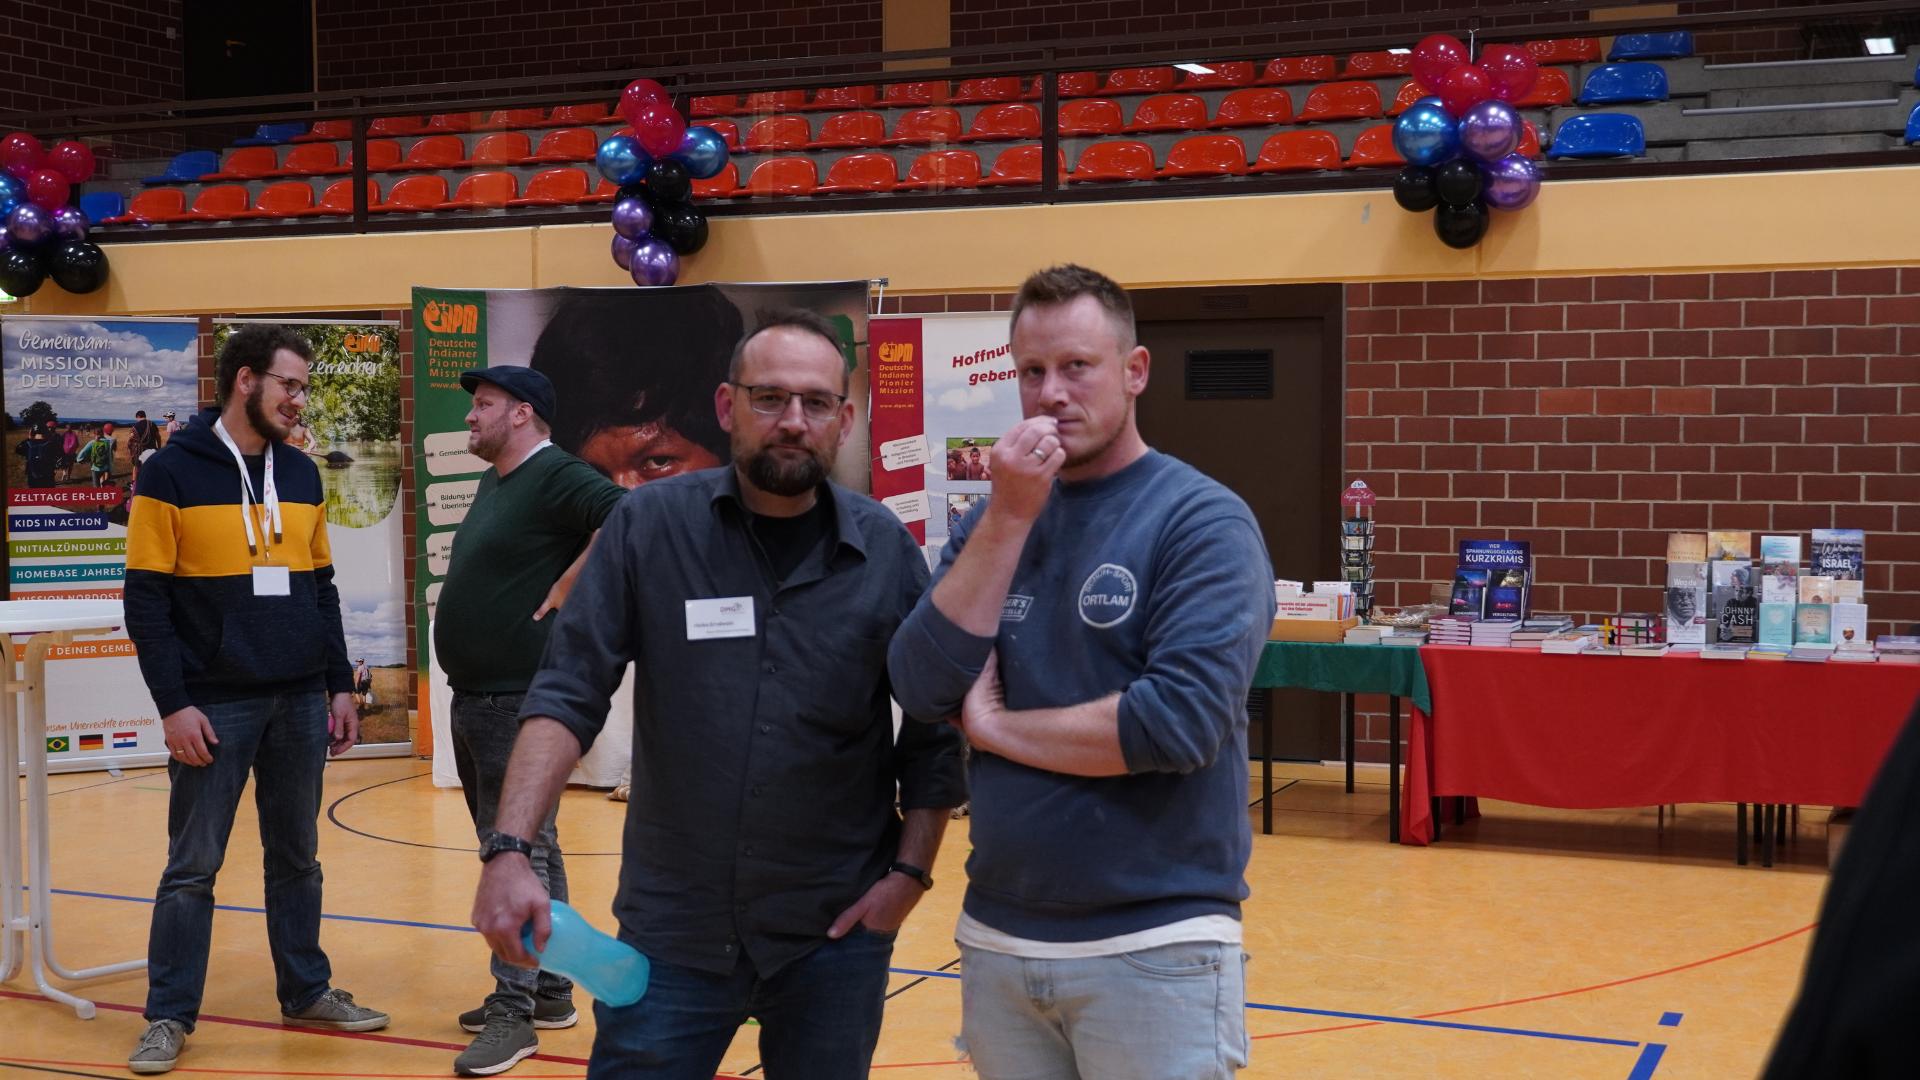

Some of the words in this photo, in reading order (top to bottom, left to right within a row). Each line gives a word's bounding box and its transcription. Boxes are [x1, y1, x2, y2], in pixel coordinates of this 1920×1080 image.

[429, 338, 477, 348] Deutsche
[429, 348, 478, 358] Indianer
[21, 357, 102, 370] MISSION
[109, 357, 128, 369] IN
[429, 358, 478, 368] Pionier
[22, 375, 164, 388] DEUTSCHLAND
[969, 369, 1017, 386] geben
[14, 493, 68, 502] ZELTTAGE
[73, 492, 117, 500] ER-LEBT
[440, 493, 466, 501] Bildung
[15, 519, 40, 528] KIDS
[45, 519, 56, 527] IN
[60, 518, 102, 526] ACTION
[16, 542, 111, 553] INITIALZÜNDUNG
[1465, 554, 1524, 564] KURZKRIMIS
[1823, 559, 1852, 568] ISRAEL
[16, 569, 78, 579] HOMEBASE
[68, 592, 121, 600] NORDOST
[1083, 594, 1129, 606] ORTLAM
[1721, 614, 1753, 625] CASH
[57, 646, 97, 655] DEINER
